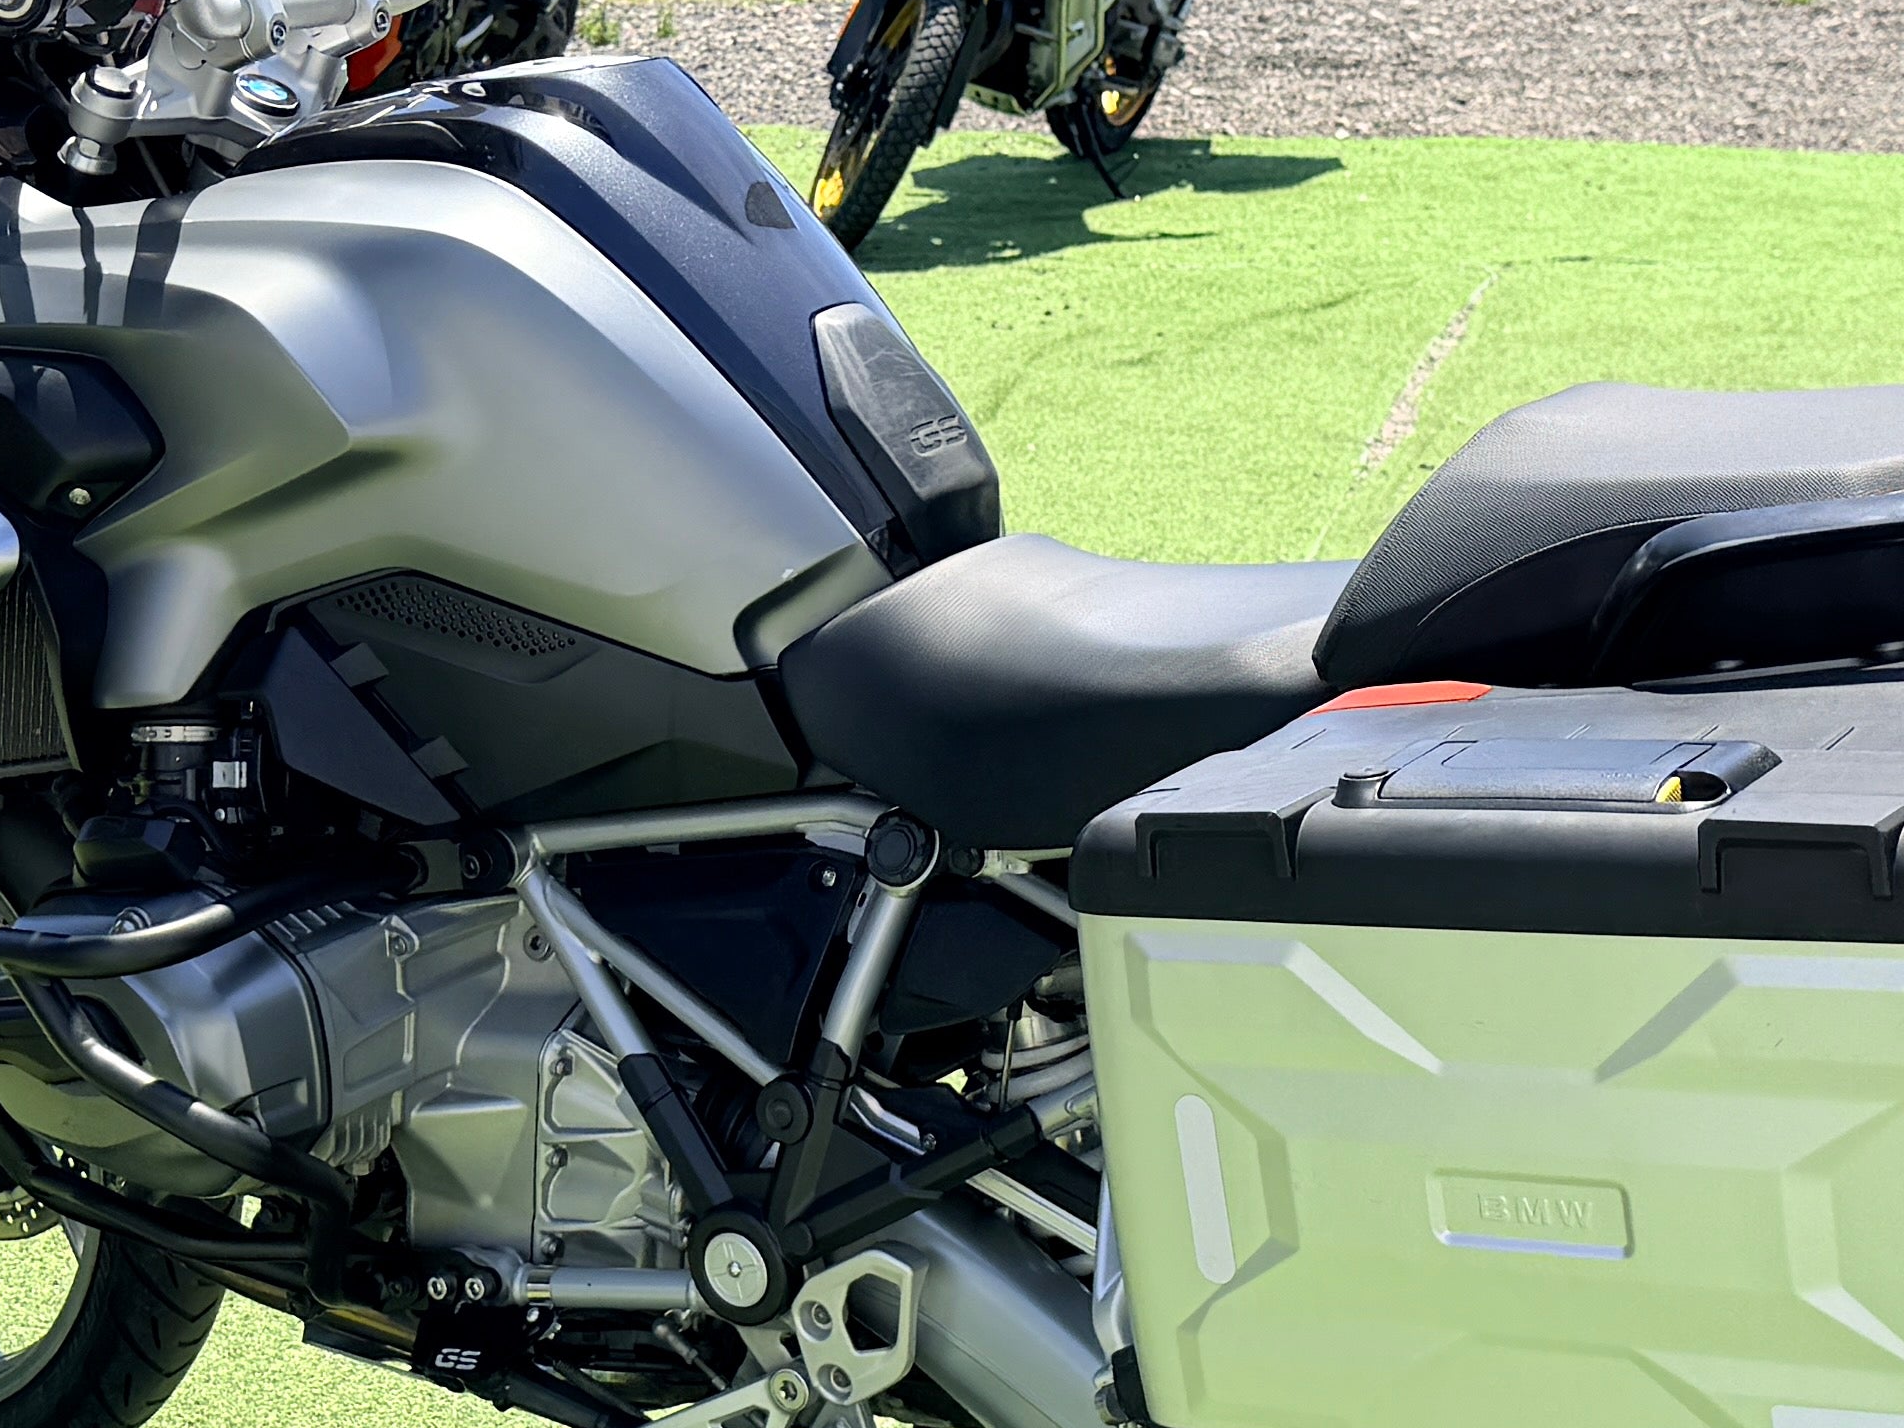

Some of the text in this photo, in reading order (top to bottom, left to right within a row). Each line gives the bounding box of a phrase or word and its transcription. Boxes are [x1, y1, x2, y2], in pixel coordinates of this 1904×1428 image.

[908, 414, 968, 458] GS
[1477, 1193, 1594, 1229] BMW
[434, 1347, 482, 1371] GS
